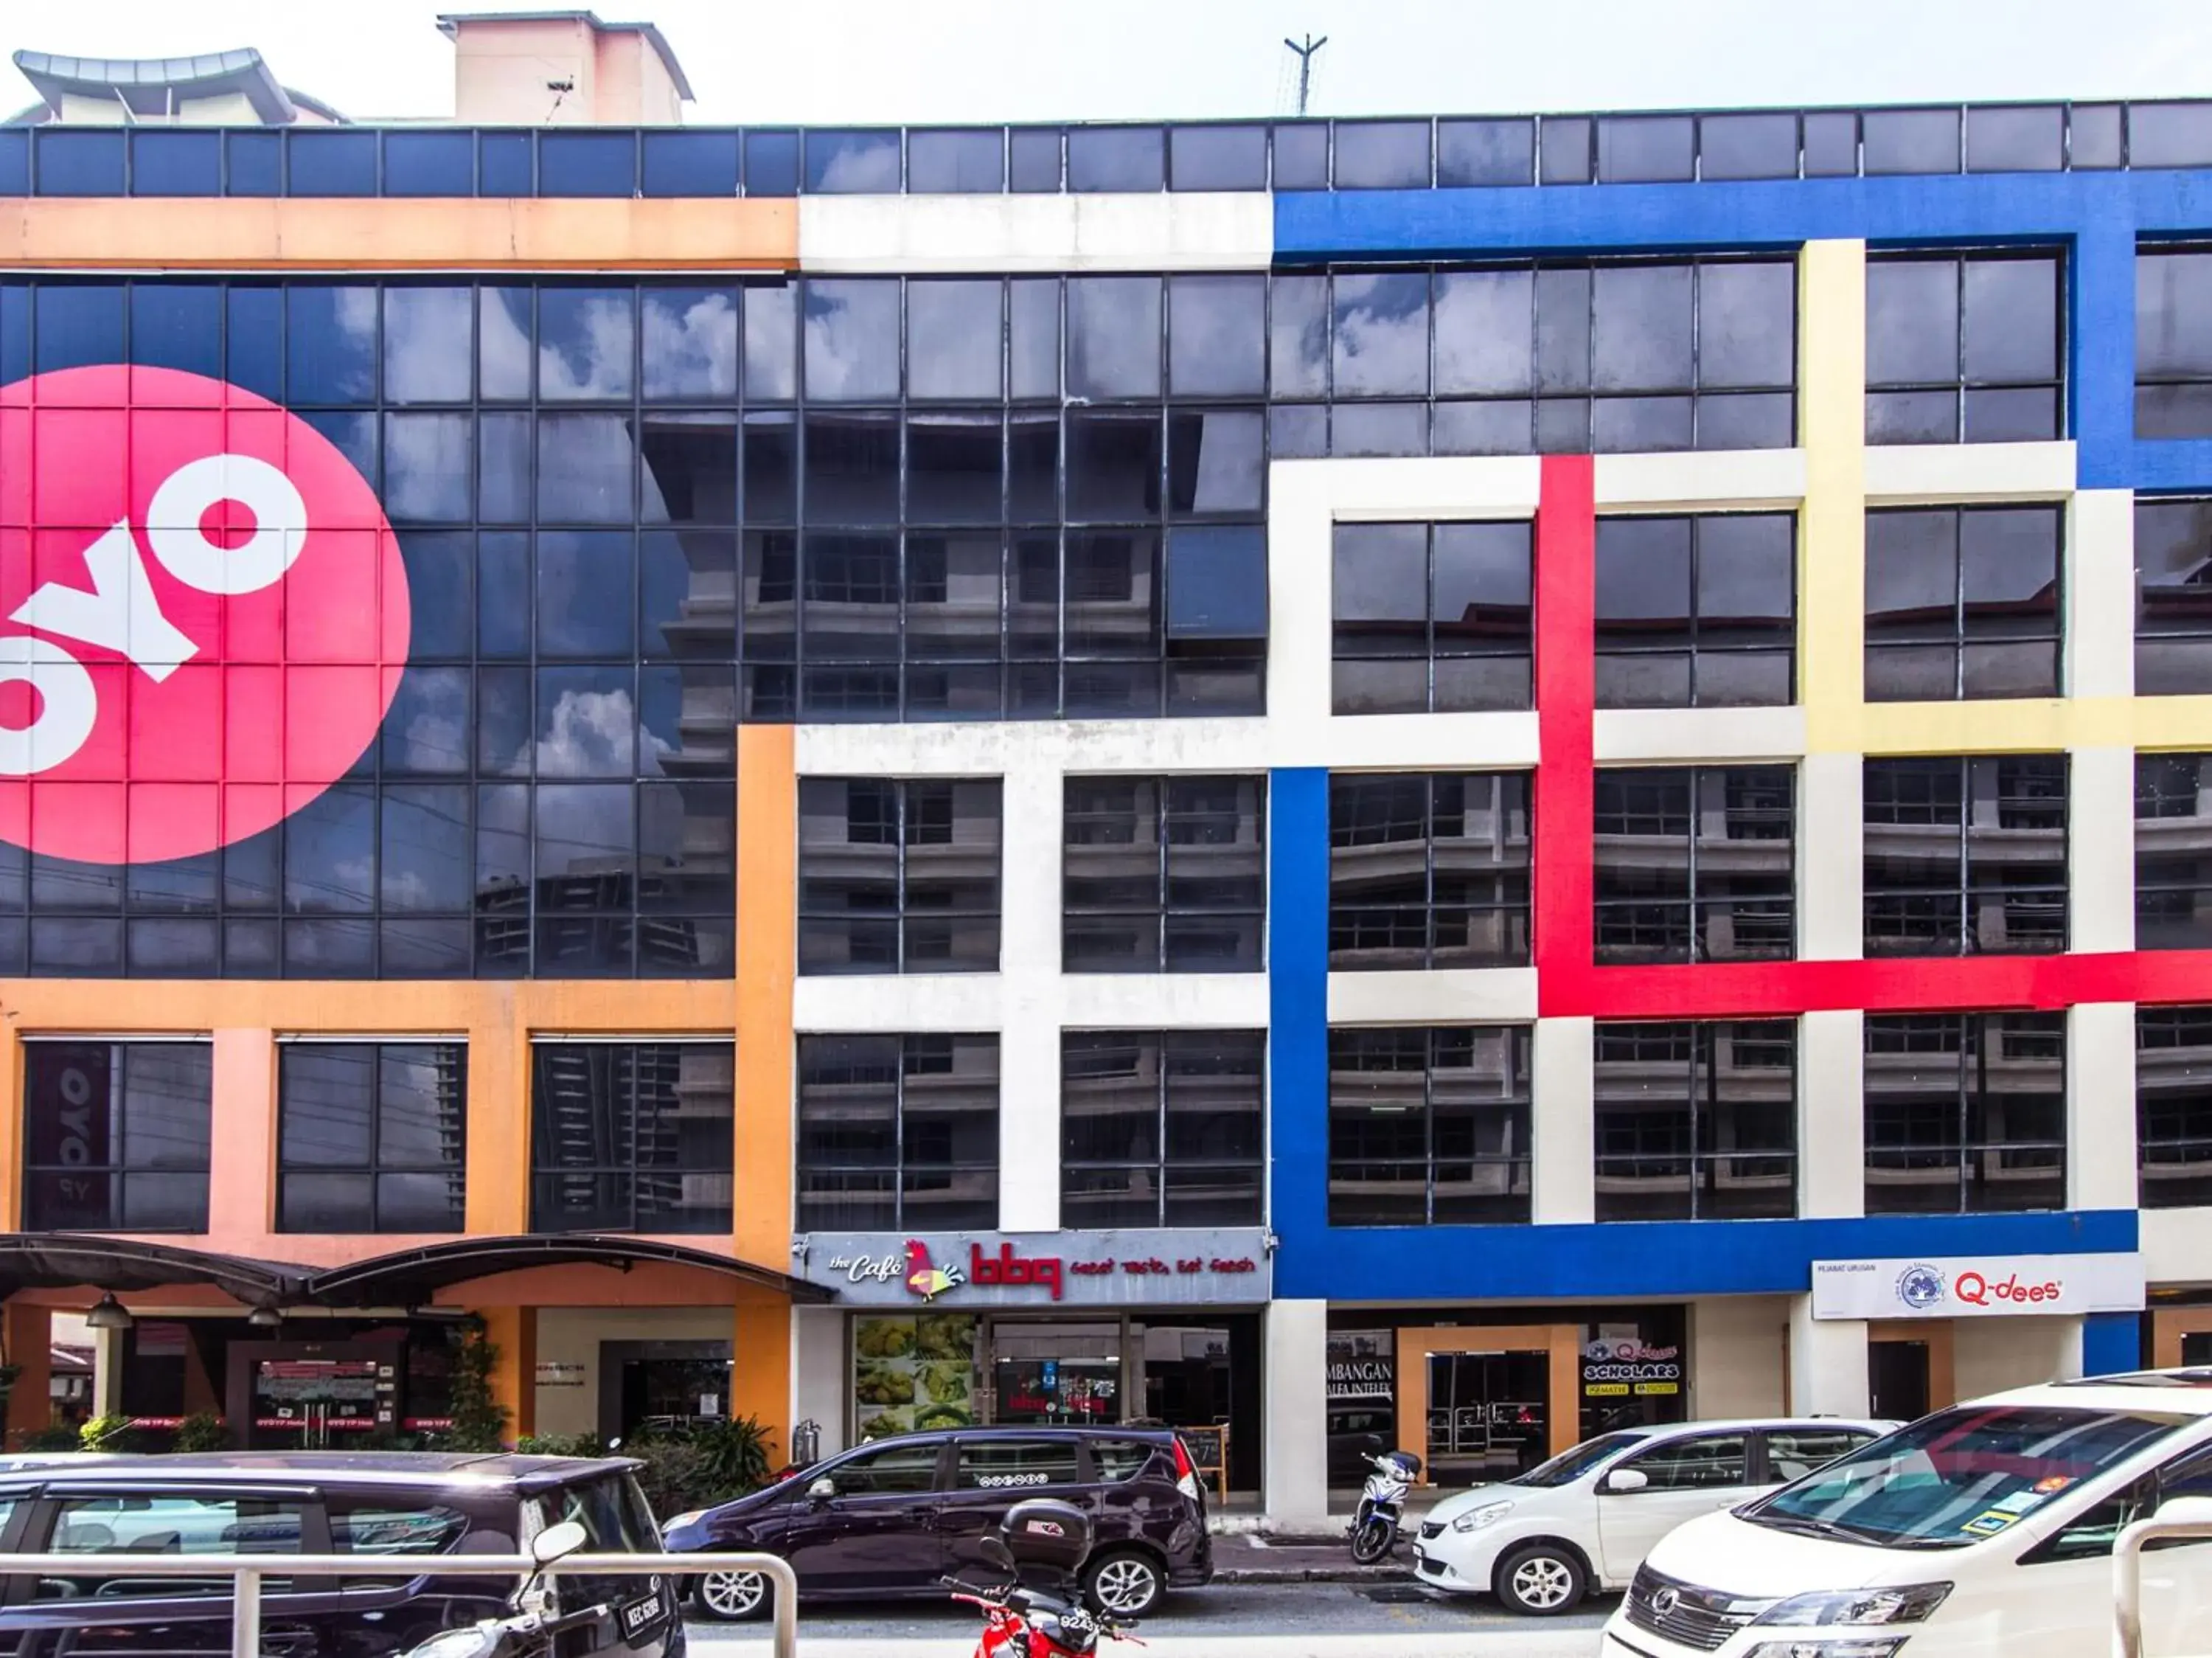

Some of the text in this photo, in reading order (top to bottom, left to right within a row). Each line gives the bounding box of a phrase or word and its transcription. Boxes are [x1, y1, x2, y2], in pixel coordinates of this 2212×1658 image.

[0, 454, 307, 775] OYO
[829, 1256, 850, 1269] the
[971, 1243, 1061, 1301] bbq
[1177, 1257, 1203, 1273] Eat
[1955, 1272, 2059, 1305] Q-dees
[1584, 1364, 1680, 1381] SCHOLARS
